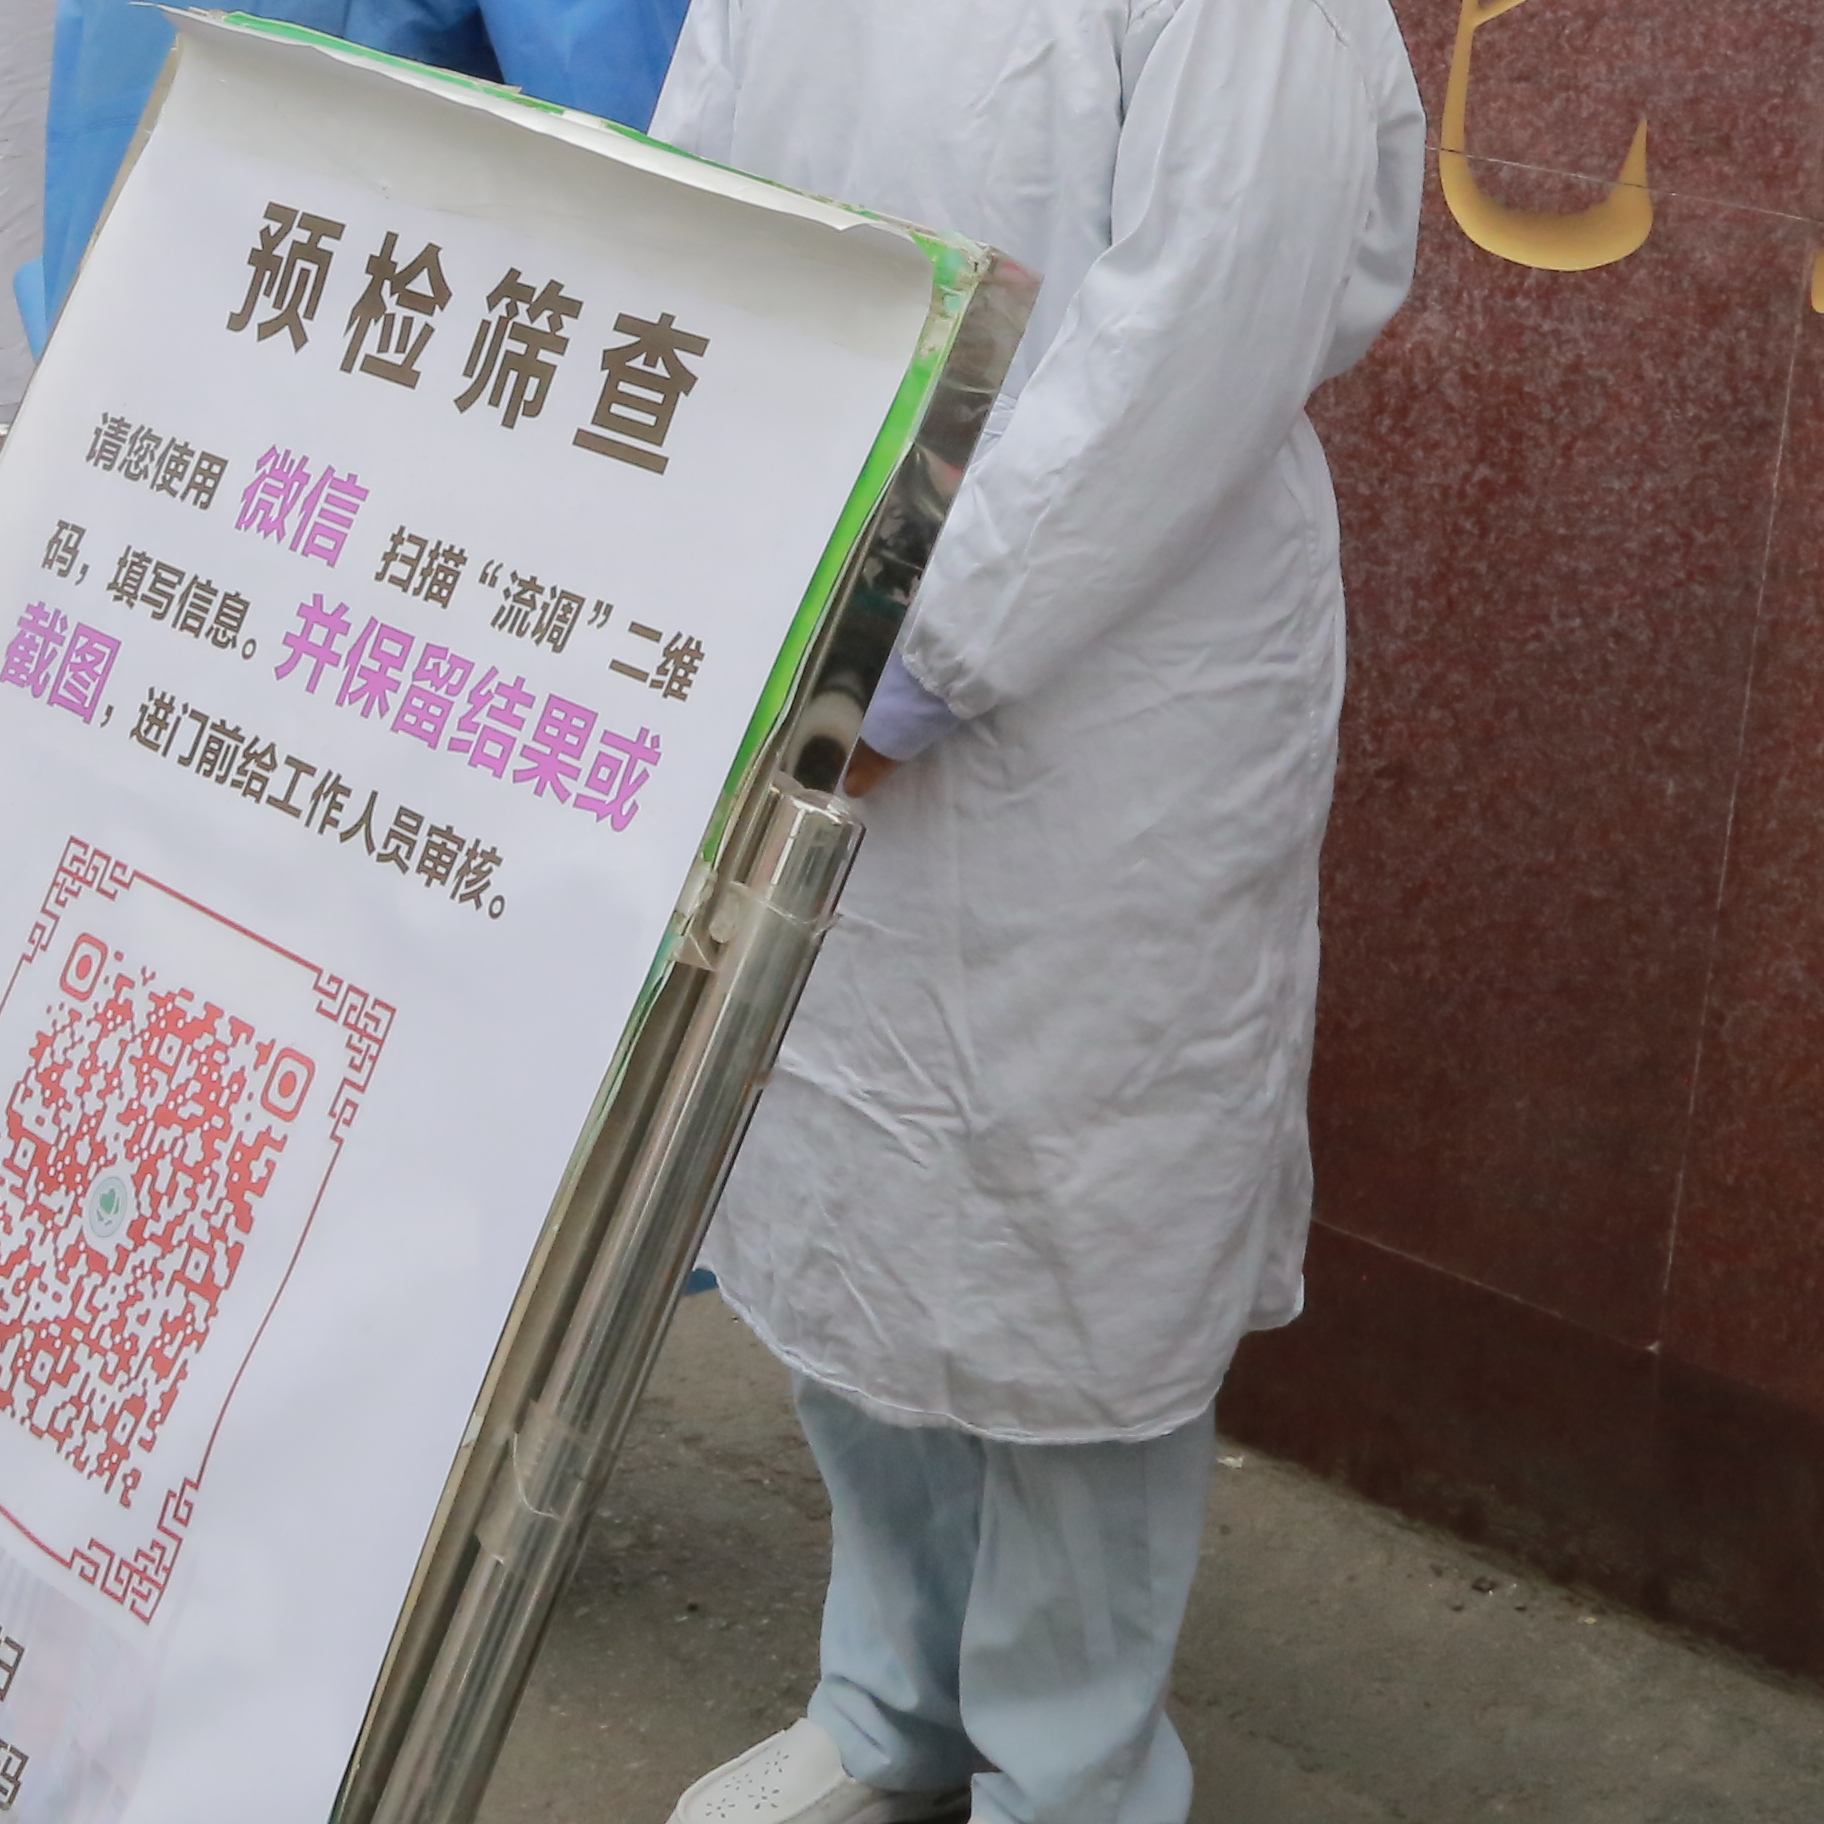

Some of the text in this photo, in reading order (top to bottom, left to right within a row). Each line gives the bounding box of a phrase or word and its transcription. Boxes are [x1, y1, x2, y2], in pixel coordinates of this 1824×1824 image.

[227, 202, 711, 476] 预检筛查
[84, 413, 229, 511] 请您使用
[234, 444, 368, 567] 微信
